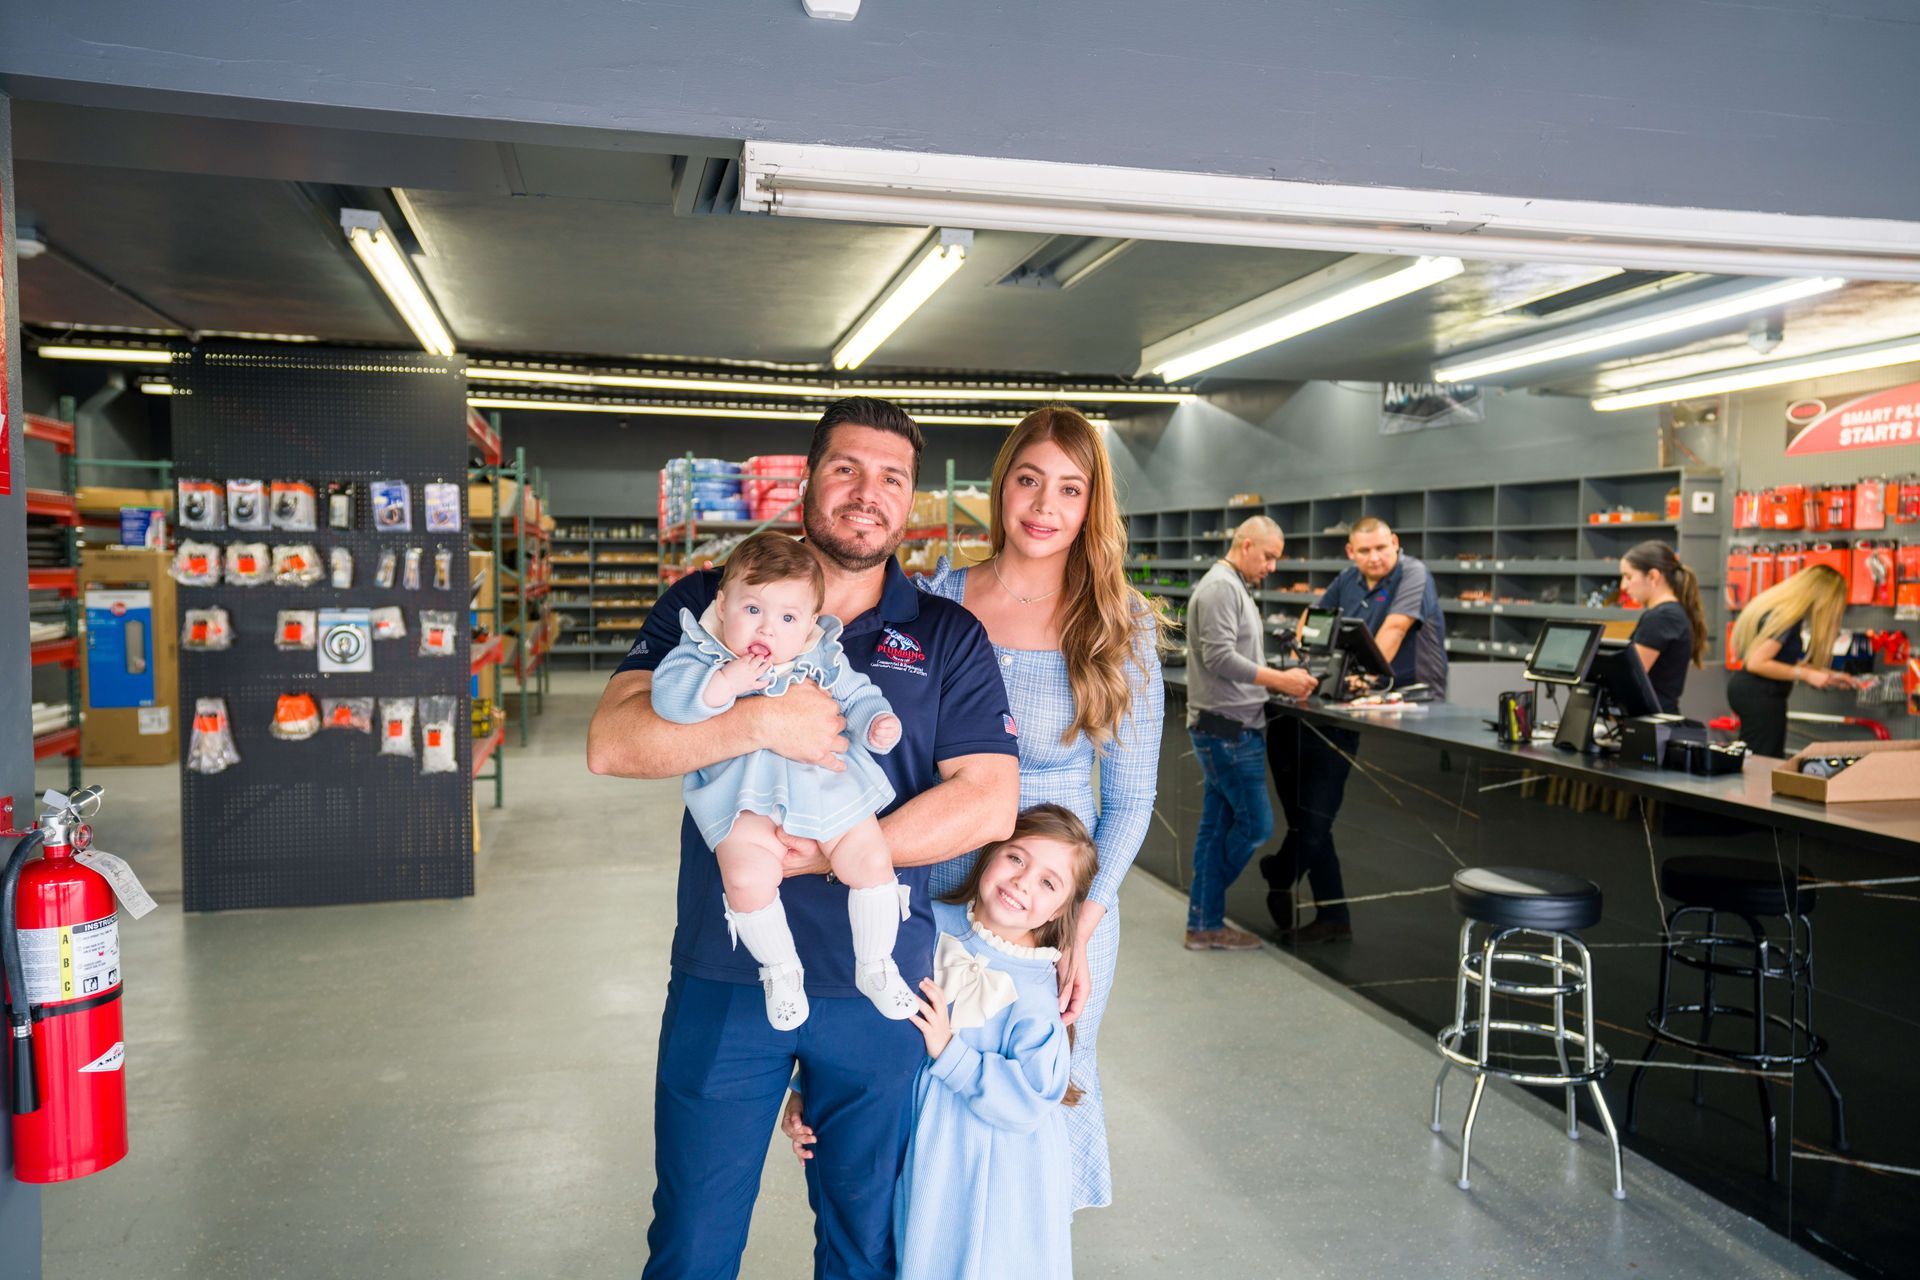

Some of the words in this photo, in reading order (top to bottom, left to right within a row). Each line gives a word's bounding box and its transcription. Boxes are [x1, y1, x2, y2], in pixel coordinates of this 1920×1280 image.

[1841, 406, 1893, 427] SMART
[1839, 421, 1913, 446] STARTS
[877, 644, 926, 661] PLUMBING
[62, 934, 69, 945] A
[63, 958, 70, 968] B
[64, 981, 71, 992] C
